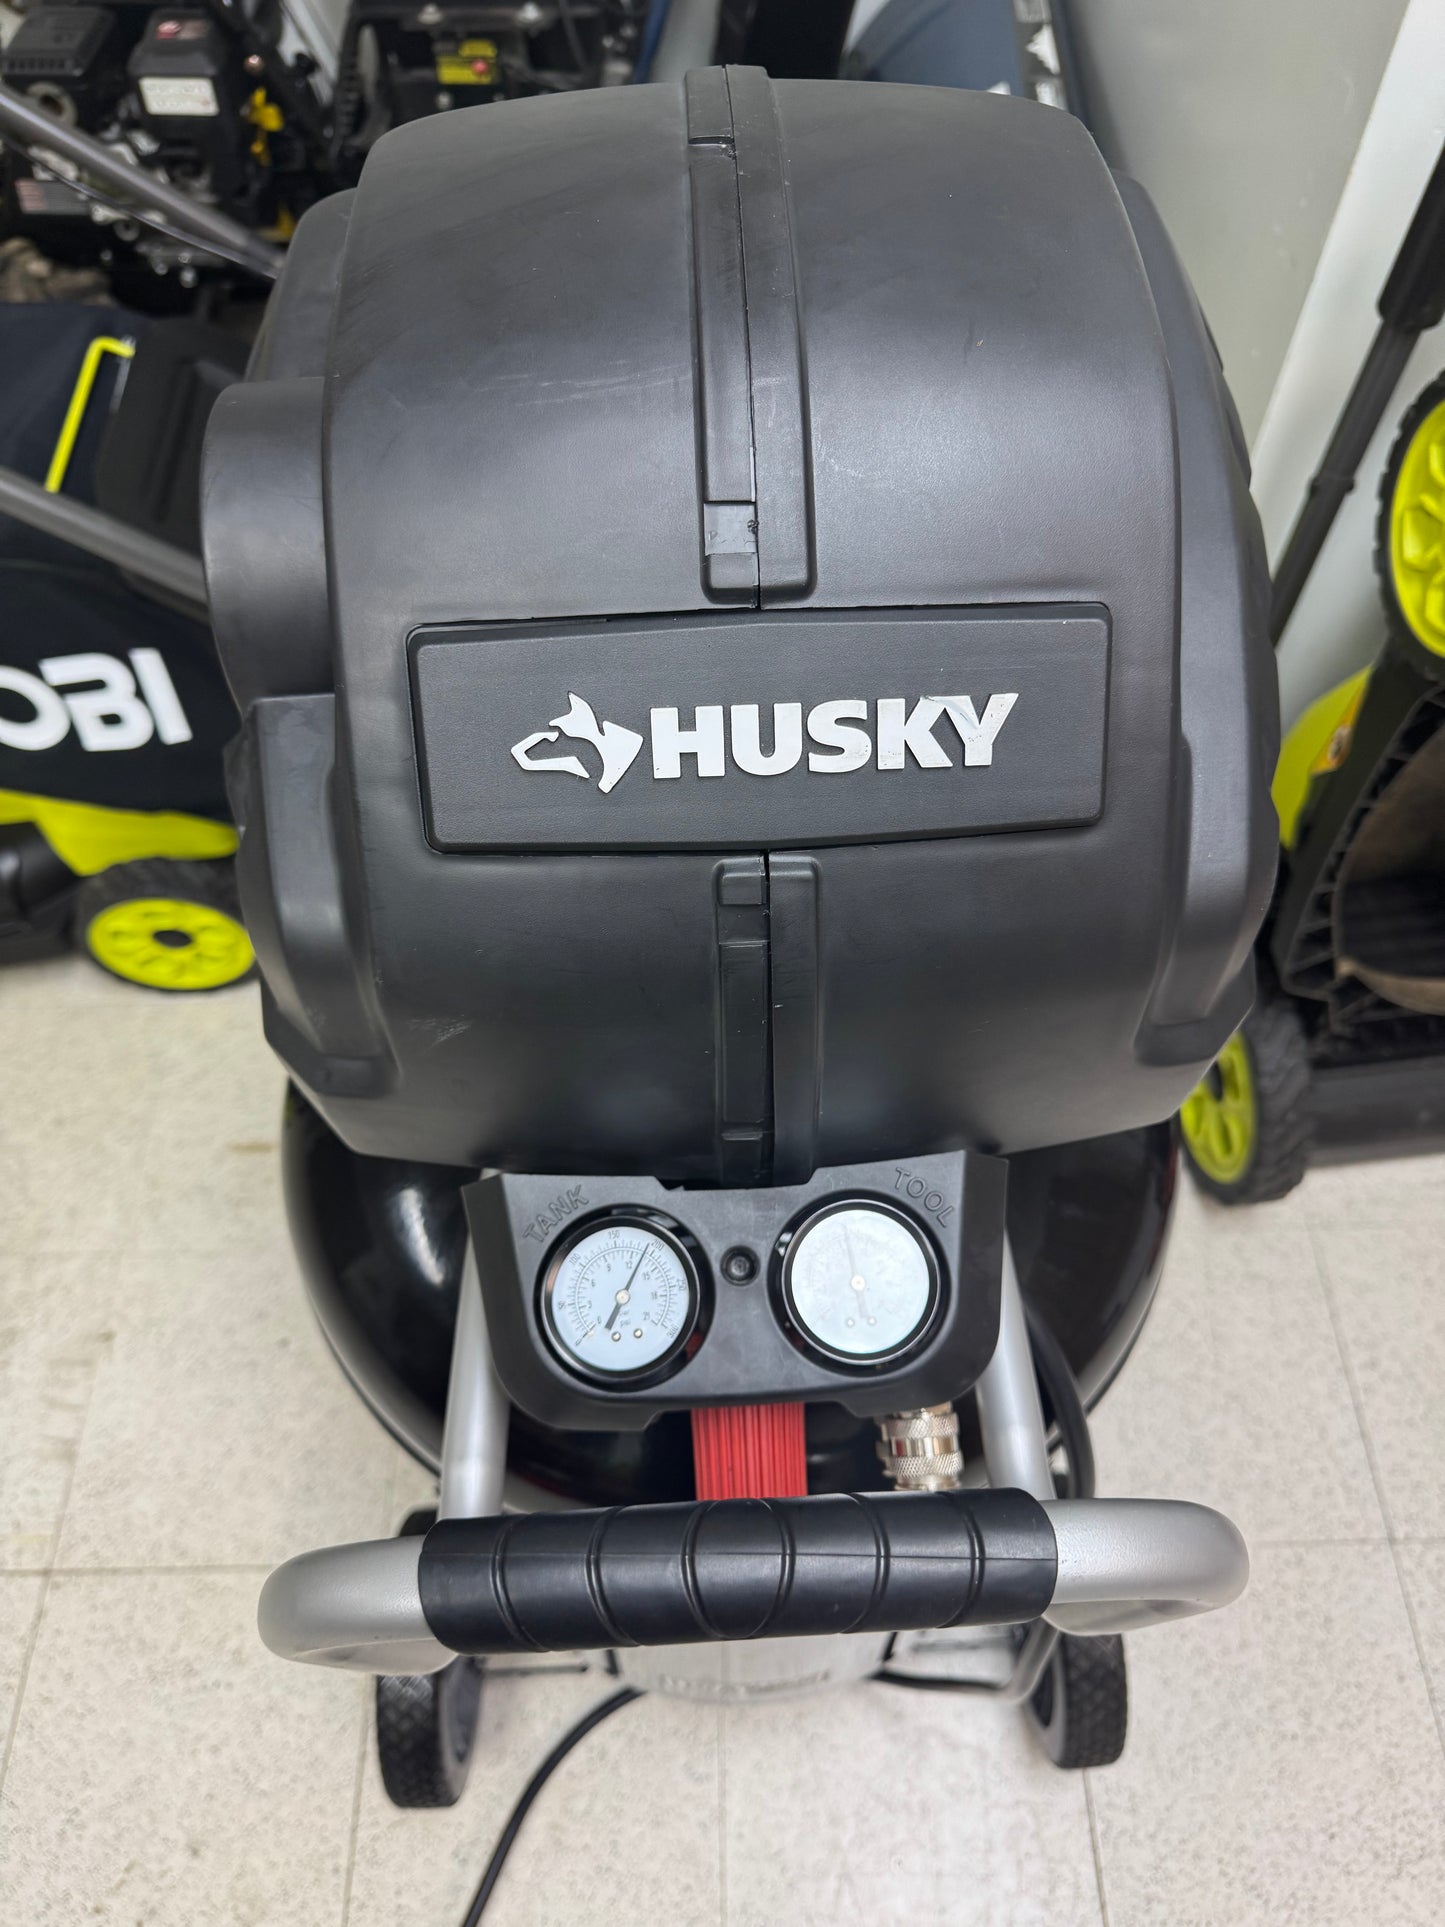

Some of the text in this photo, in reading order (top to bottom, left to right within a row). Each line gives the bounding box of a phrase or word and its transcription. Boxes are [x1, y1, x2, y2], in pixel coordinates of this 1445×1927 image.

[650, 693, 1019, 779] HUSKY
[895, 1167, 957, 1229] TOOL
[522, 1184, 590, 1244] TANK
[608, 1230, 620, 1239] 150
[651, 1239, 664, 1251] 200
[569, 1253, 581, 1265] 100
[625, 1261, 633, 1269] 12
[677, 1279, 687, 1291] 250
[667, 1325, 680, 1338] 300
